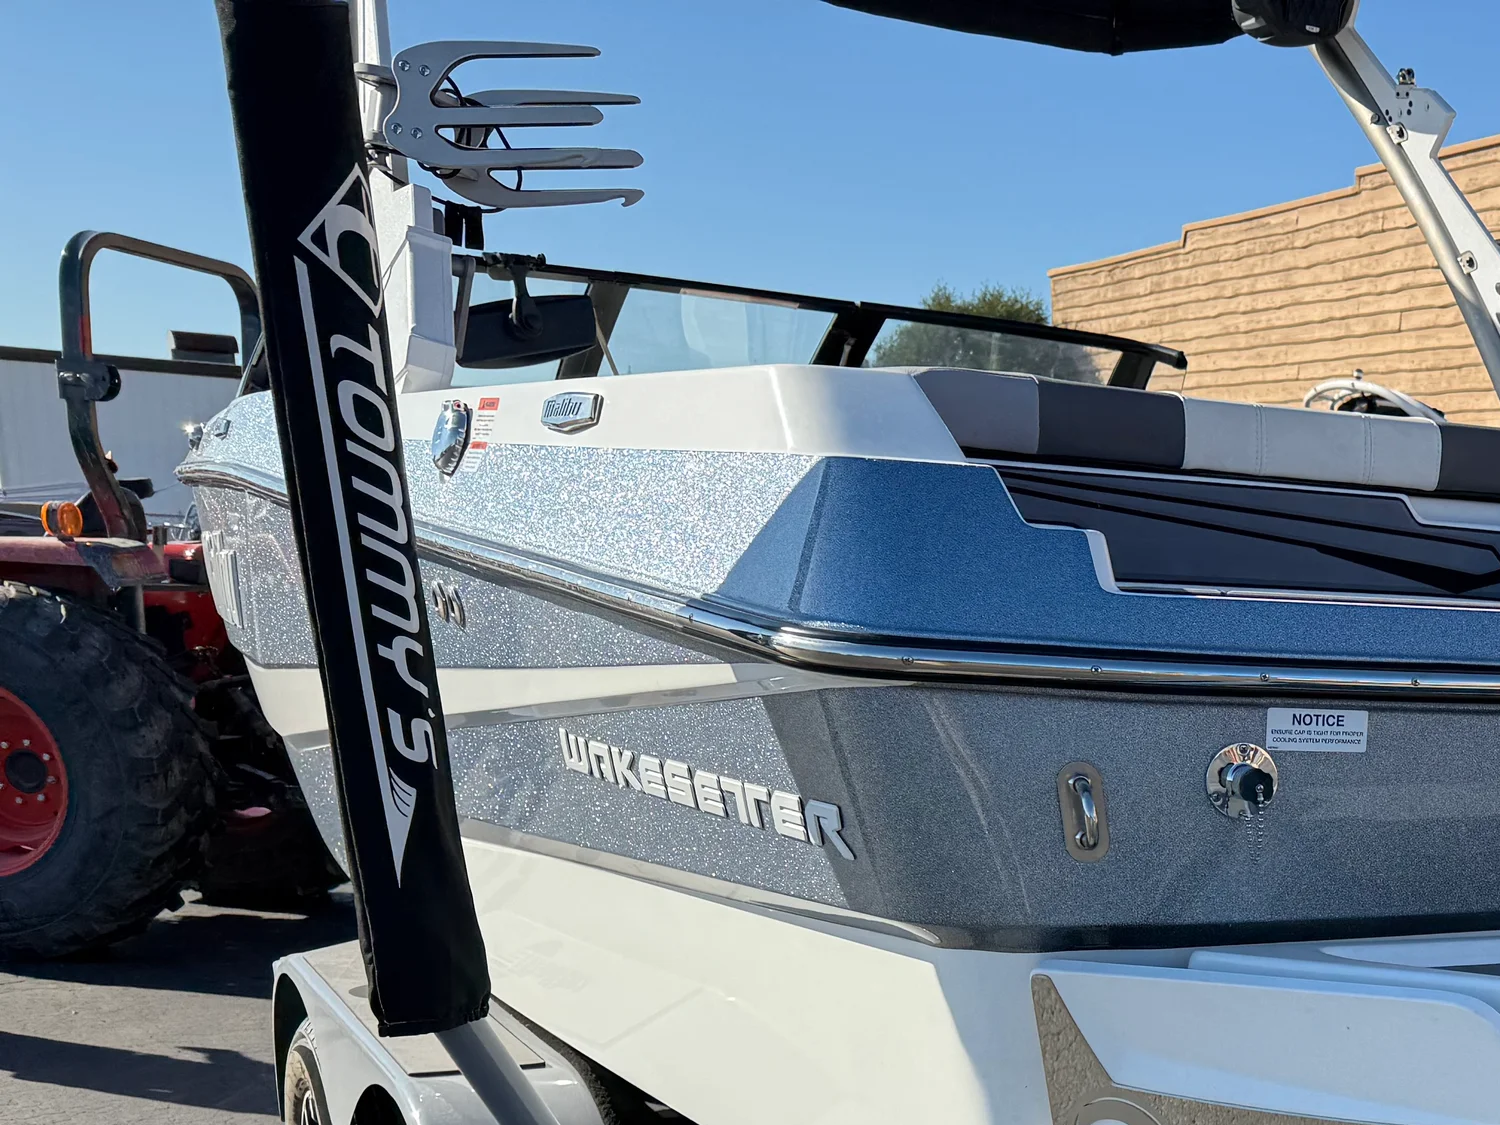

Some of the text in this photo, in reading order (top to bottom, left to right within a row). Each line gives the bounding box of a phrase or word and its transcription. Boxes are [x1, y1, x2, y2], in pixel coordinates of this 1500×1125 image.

[544, 398, 583, 418] Malibu
[1292, 713, 1345, 727] NOTICE
[558, 727, 856, 861] WAKESETTER
